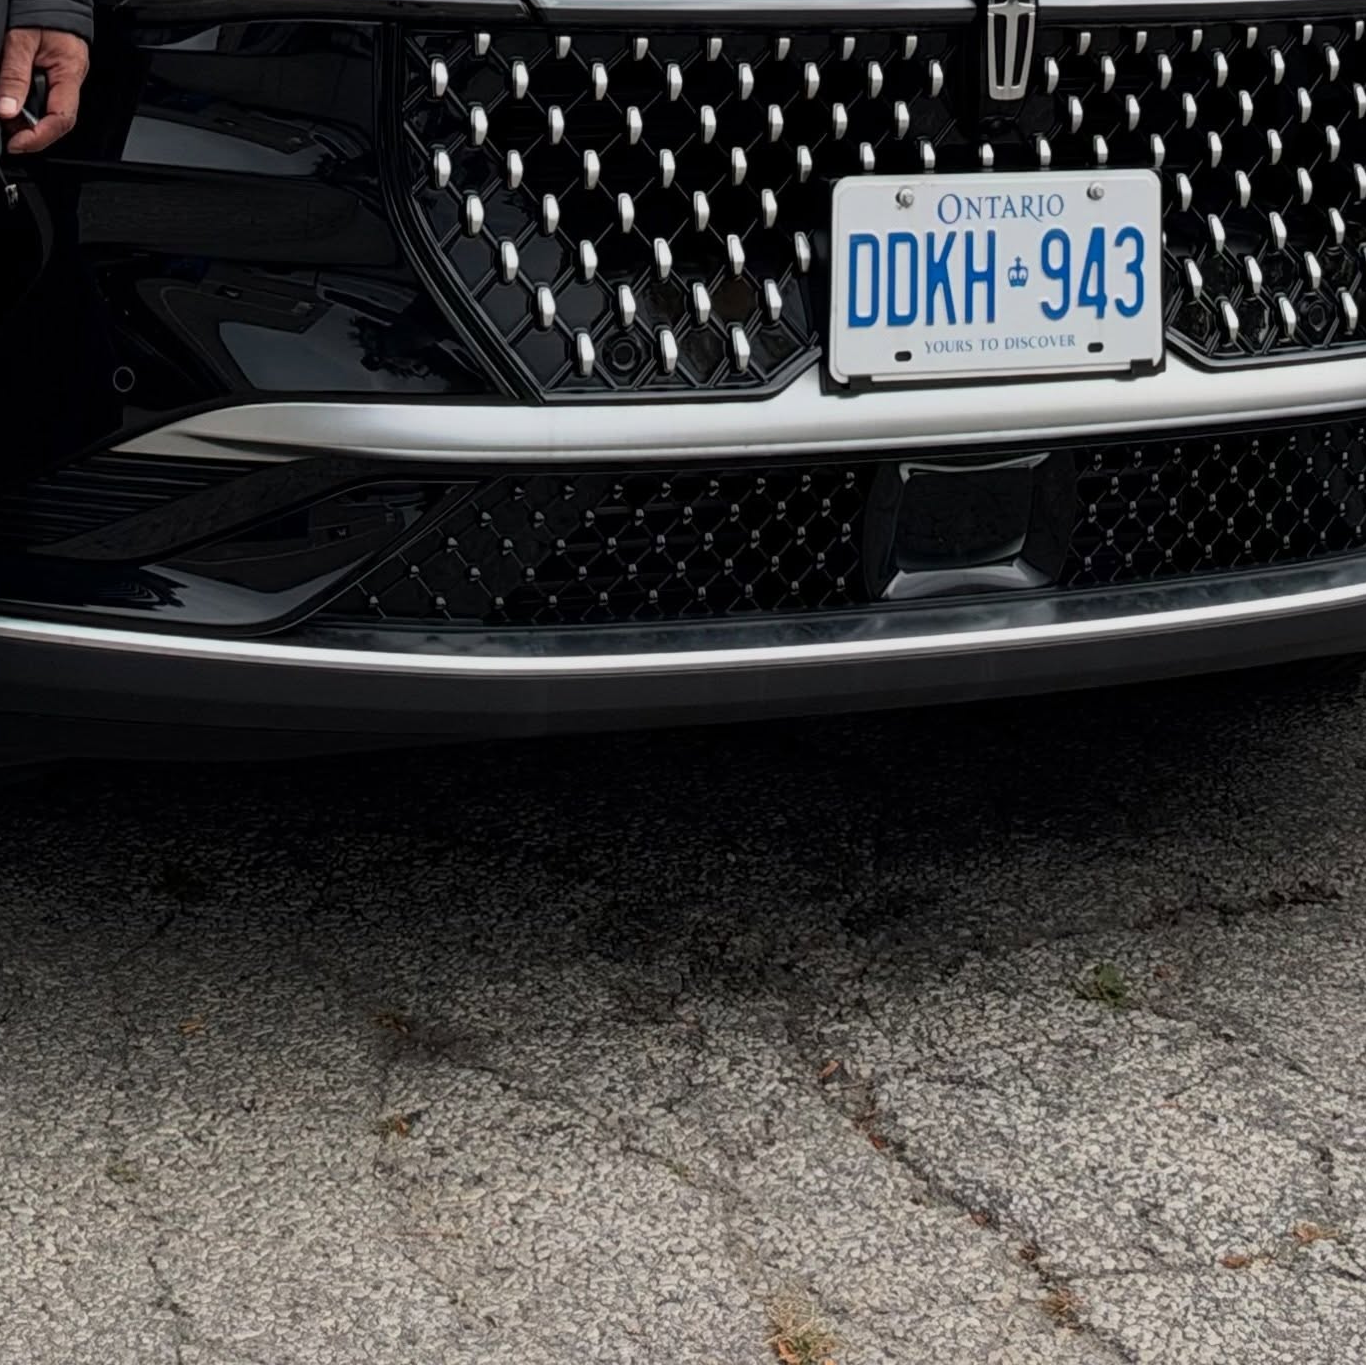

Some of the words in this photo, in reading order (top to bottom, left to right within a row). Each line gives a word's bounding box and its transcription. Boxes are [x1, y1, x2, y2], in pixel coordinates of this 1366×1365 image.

[937, 193, 1065, 224] ONTARIO
[848, 230, 996, 328] DDKH
[1040, 226, 1145, 321] 943
[924, 336, 973, 354] YOURS
[979, 338, 999, 351] TO
[1004, 334, 1076, 350] DISCOVER
